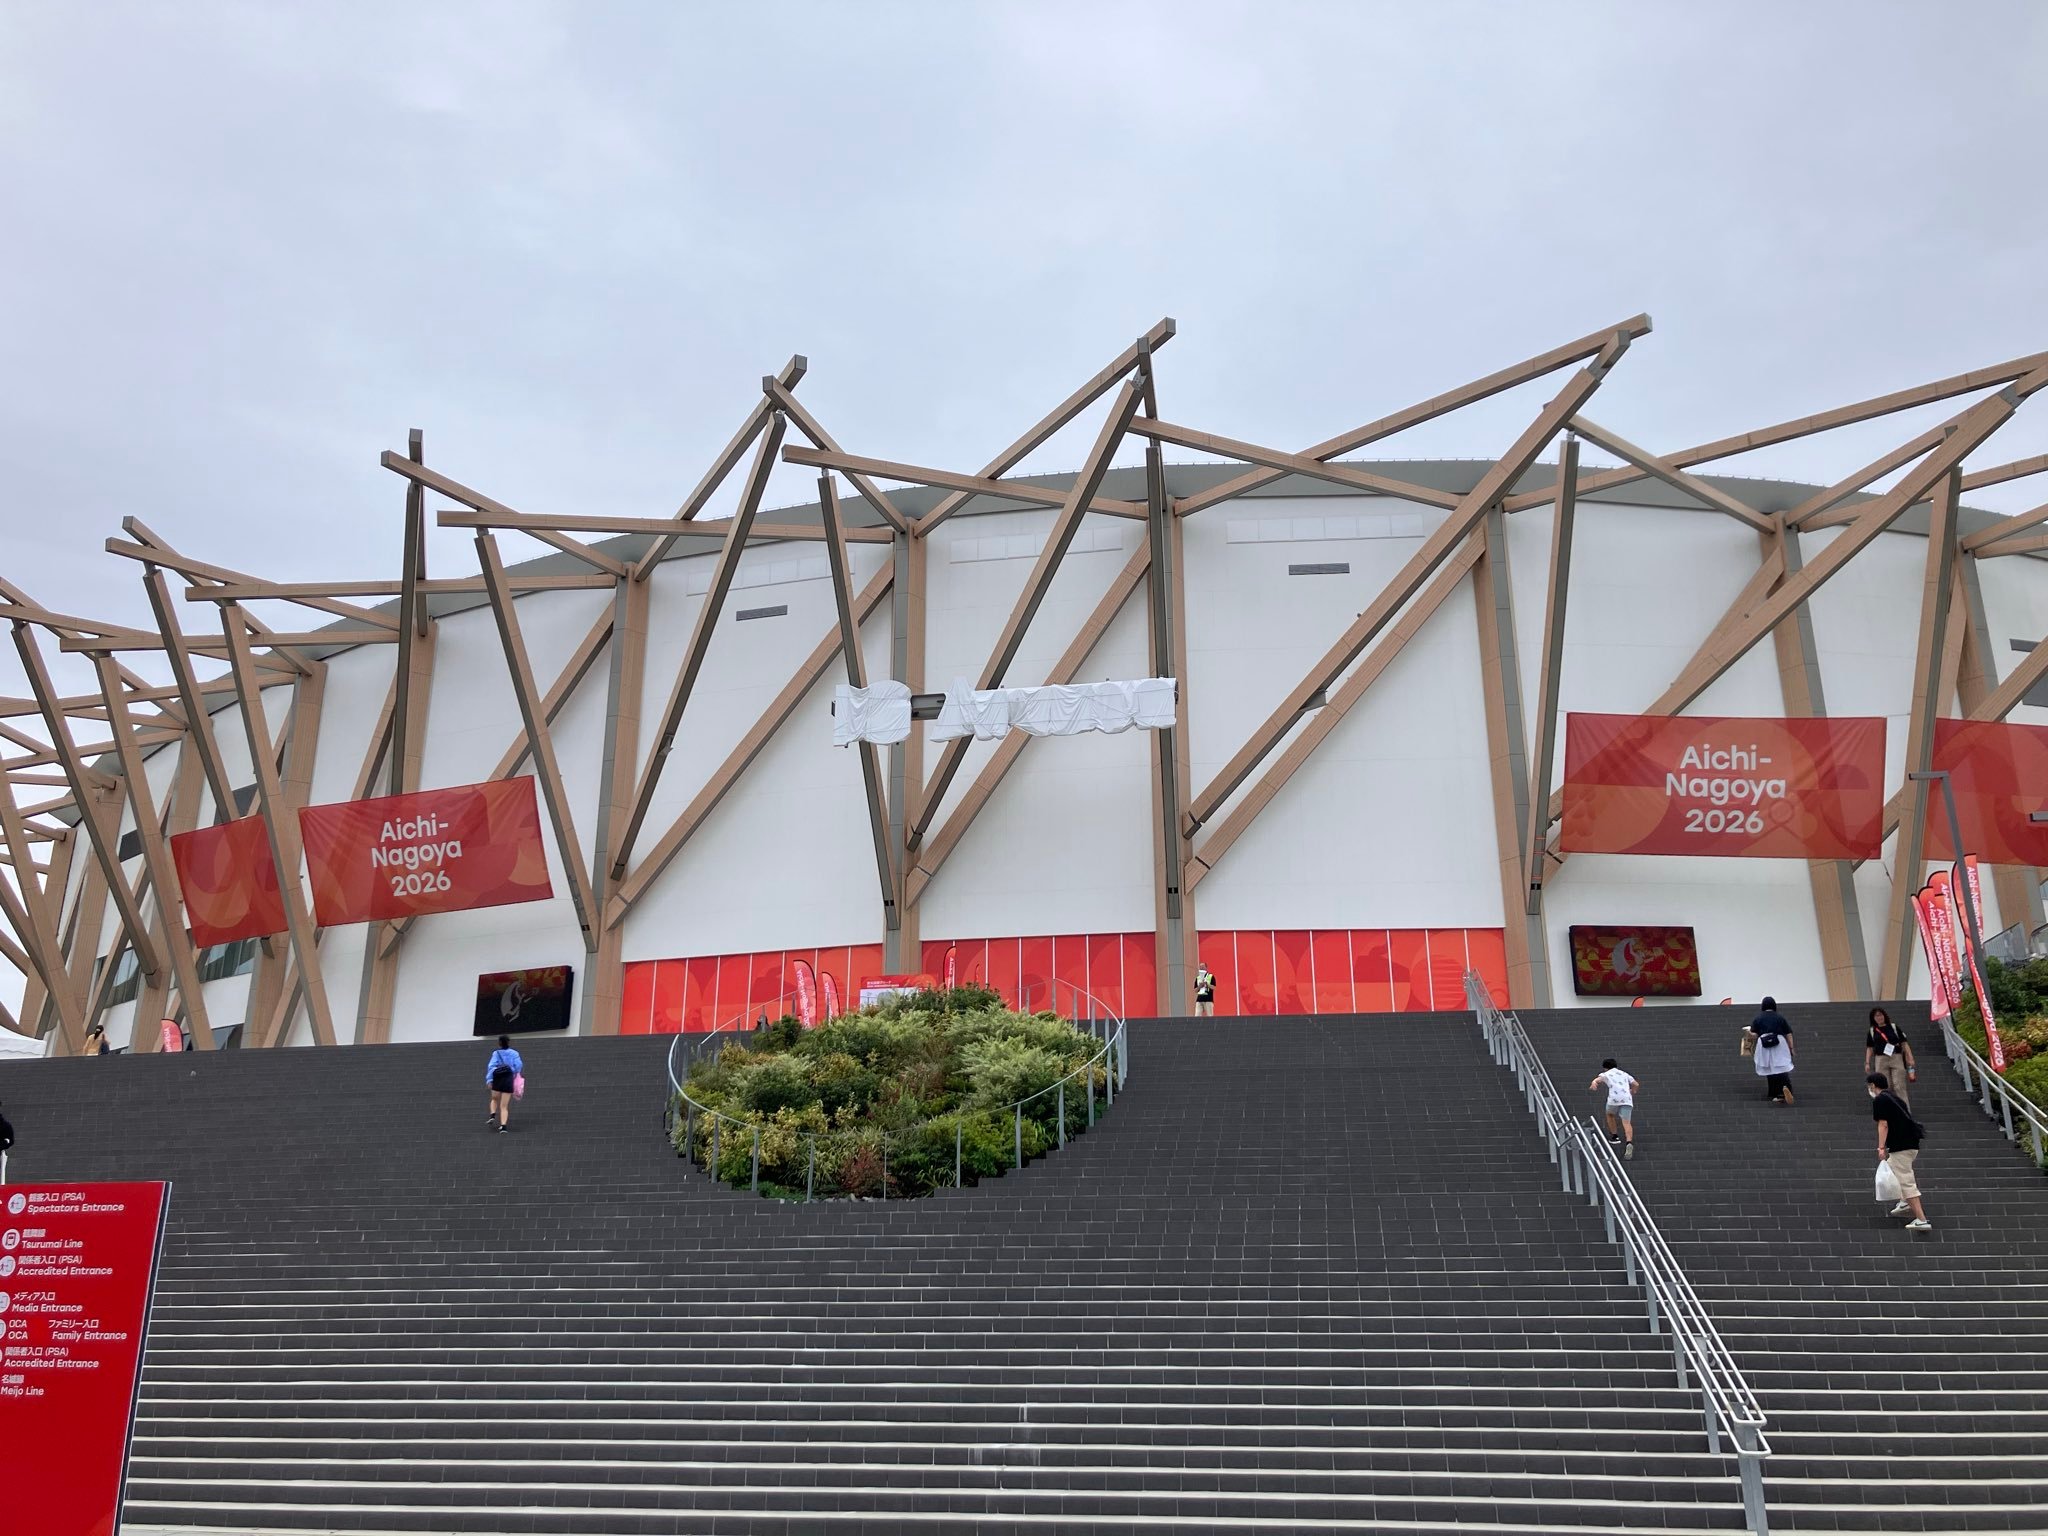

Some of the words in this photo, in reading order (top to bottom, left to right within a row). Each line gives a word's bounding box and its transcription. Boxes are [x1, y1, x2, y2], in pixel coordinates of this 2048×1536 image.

[1680, 743, 1772, 771] Aichi-
[1665, 772, 1786, 806] Nagoya
[380, 812, 449, 842] Aichi-
[1684, 808, 1765, 834] 2026
[371, 840, 462, 870] Nagoya
[391, 870, 451, 896] 2026
[1992, 1035, 2005, 1064] 2026
[62, 1192, 86, 1202] (PSA)
[28, 1204, 80, 1215] Spectators
[81, 1203, 125, 1213] Entrance
[22, 1240, 63, 1249] Tsurumai
[64, 1239, 84, 1248] Line
[59, 1255, 83, 1265] (PSA)
[17, 1266, 68, 1276] Accredited
[70, 1266, 113, 1275] Entrance
[12, 1303, 39, 1312] Media
[41, 1303, 83, 1312] Entrance
[9, 1319, 28, 1328] OCA
[8, 1331, 28, 1340] OCA
[52, 1330, 82, 1342] Family
[84, 1331, 128, 1340] Entrance
[45, 1347, 69, 1357] (PSA)
[4, 1358, 55, 1368] Accredited
[56, 1359, 100, 1368] Entrance
[0, 1385, 24, 1397] Meijo
[26, 1385, 45, 1396] Line
